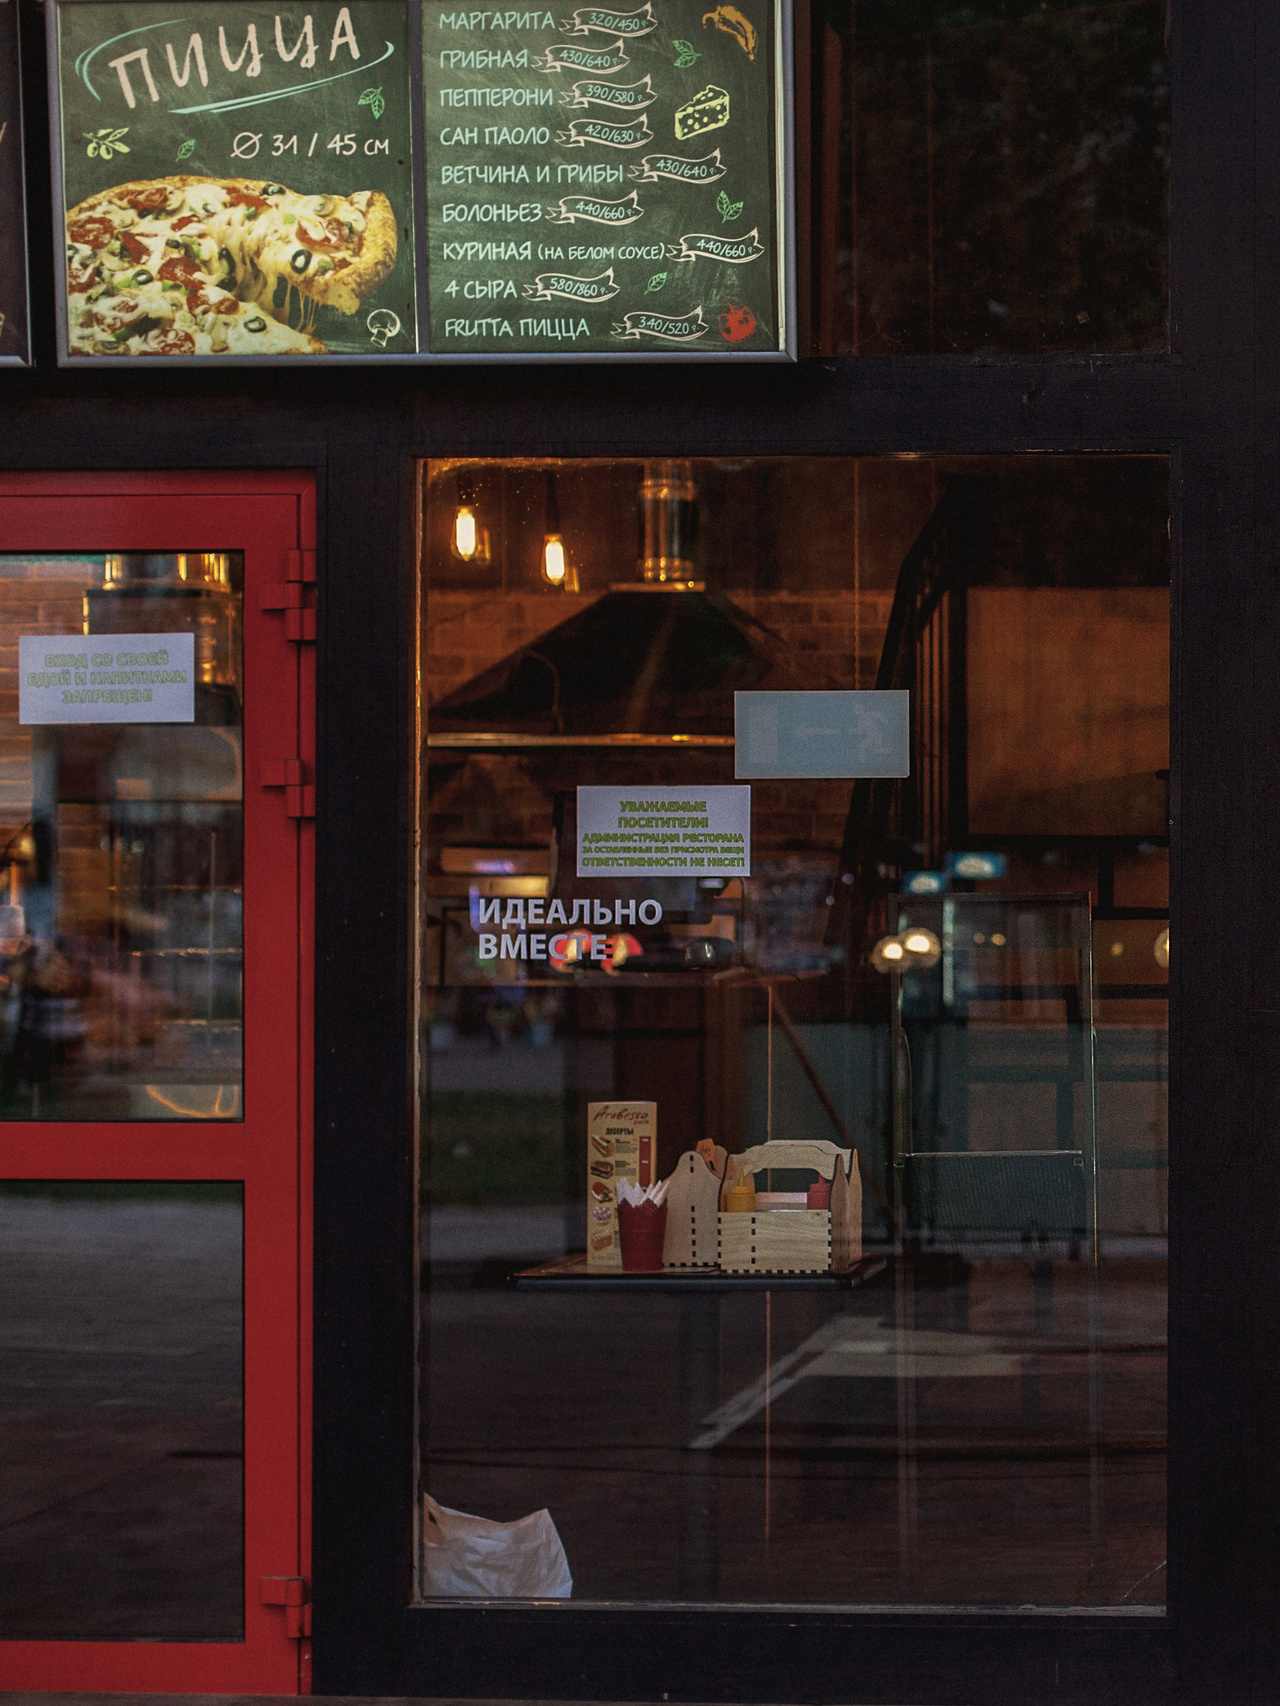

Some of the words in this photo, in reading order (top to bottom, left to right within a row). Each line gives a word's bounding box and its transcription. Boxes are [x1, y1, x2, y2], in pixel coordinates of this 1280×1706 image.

[439, 11, 556, 31] МАРГАРИТА
[589, 12, 640, 31] 320/450
[108, 7, 360, 108] ПИЦЦА
[440, 49, 528, 68] ГРИБНАЯ
[559, 51, 610, 68] 430/640
[440, 88, 554, 106] ПЕППЕРОНИ
[586, 84, 634, 104] 390/580
[271, 134, 297, 156] 31
[327, 133, 356, 155] 45
[440, 127, 478, 145] САН
[484, 126, 549, 145] ПАОЛО
[584, 124, 634, 142] 420/630
[442, 165, 529, 184] ВЕТЧИНА
[537, 165, 550, 183] И
[558, 164, 623, 183] ГРИБЫ
[656, 159, 707, 178] 430/640
[442, 203, 542, 223] БОЛОНЬЕЗ
[576, 201, 625, 219] 440/660
[442, 241, 531, 260] КУРИНАЯ
[538, 244, 564, 261] (НА
[569, 245, 614, 260] БЕЛОМ
[619, 242, 666, 260] СОУСЕ)
[696, 238, 746, 257] 440/660
[445, 280, 460, 298] 4
[464, 279, 517, 299] СЫРА
[549, 277, 598, 296] 580/860
[444, 318, 513, 337] FRUTTA
[519, 319, 589, 340] ПИЦЦА
[639, 316, 688, 335] 340/520
[45, 654, 88, 668] ВХОД
[92, 653, 112, 666] СО
[117, 650, 168, 665] СВОЕЙ
[28, 670, 71, 687] ЕДОЙ
[76, 672, 86, 684] И
[90, 670, 187, 684] НАПИТКАМИ
[62, 689, 153, 704] ЗАПРЕЩЕН!
[620, 801, 706, 812] УВАЖАЕМЫЕ
[618, 817, 709, 828] ПОСЕТИТЕЛИ!
[582, 833, 679, 844] АДМИНИСТРАЦИЯ
[683, 833, 744, 843] РЕСТОРАНА
[582, 857, 687, 866] ОТВЕТСТВЕННОСТИ
[690, 857, 705, 866] НЕ
[707, 857, 745, 867] НЕСЕТ!
[479, 898, 663, 929] ИДЕАЛЬНО
[479, 933, 607, 960] ВМЕСТЕ
